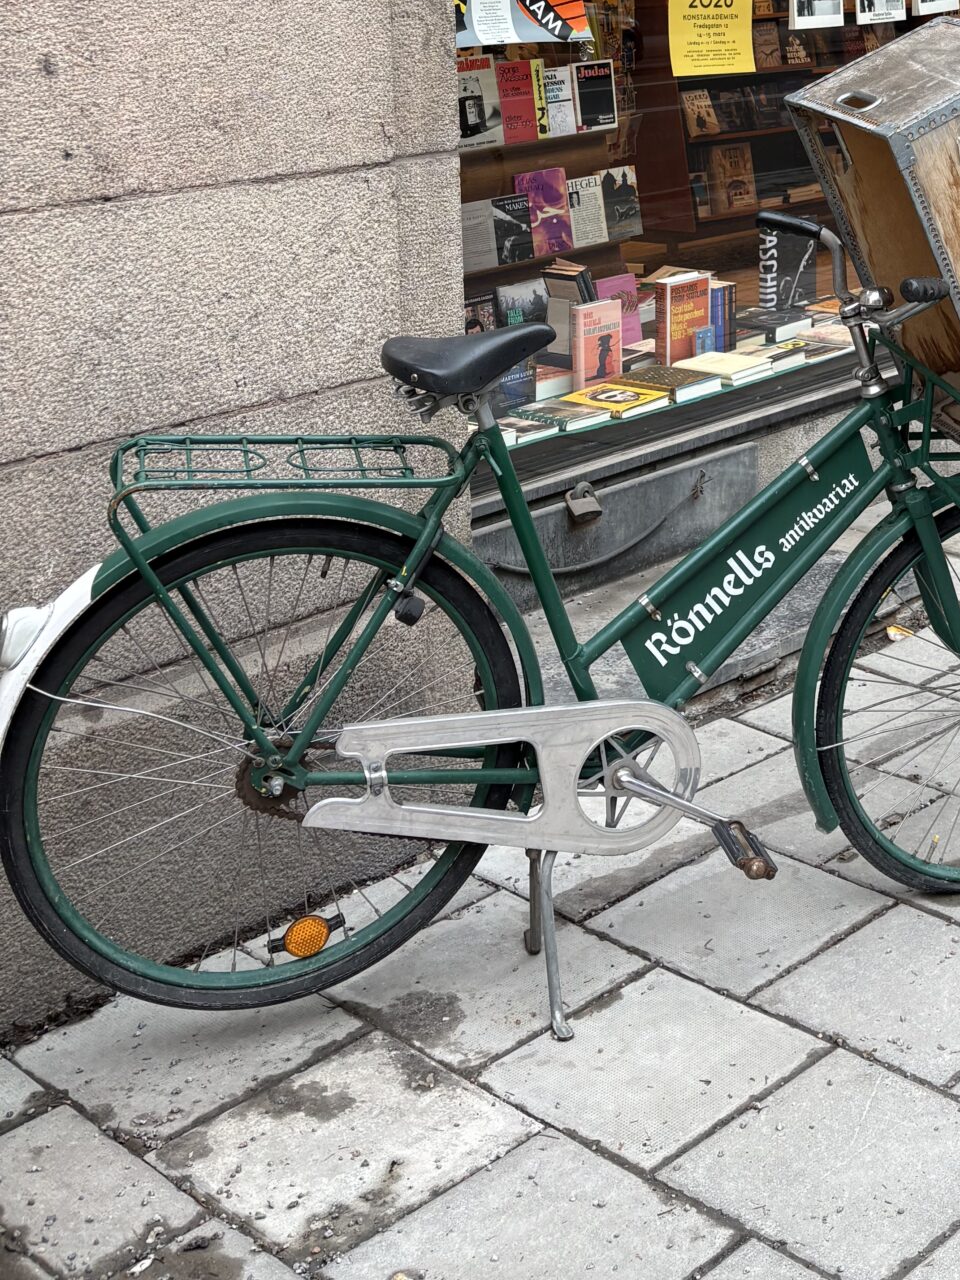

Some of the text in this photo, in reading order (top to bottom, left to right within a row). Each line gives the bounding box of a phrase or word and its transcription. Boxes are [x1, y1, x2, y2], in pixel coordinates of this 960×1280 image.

[682, 13, 739, 21] KONSTAKADEMIEN
[577, 65, 610, 78] Judas
[566, 177, 600, 192] HEGEL
[505, 201, 529, 211] MAKEN
[644, 472, 860, 668] Rönnells antikvariat
